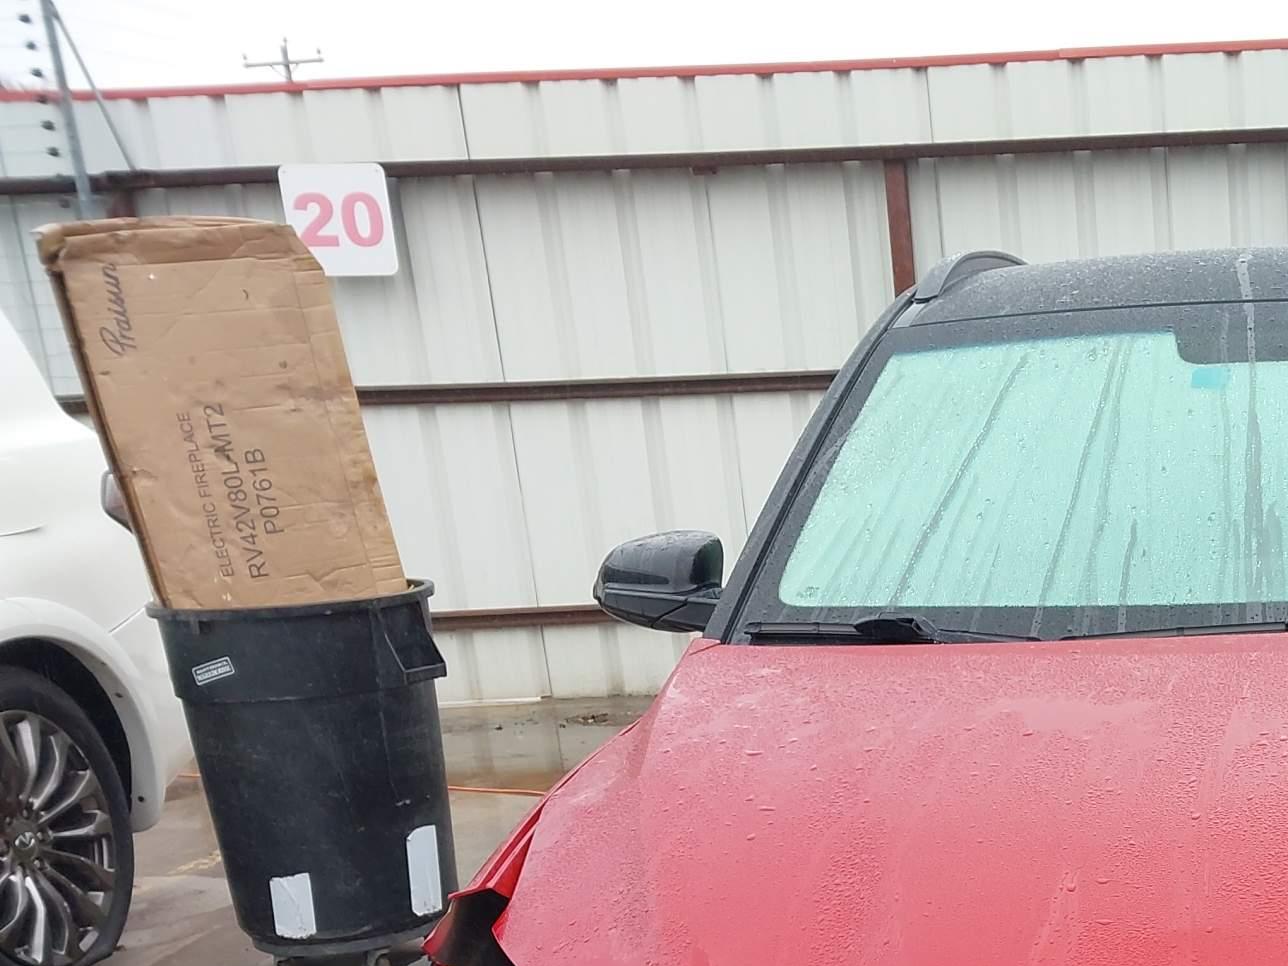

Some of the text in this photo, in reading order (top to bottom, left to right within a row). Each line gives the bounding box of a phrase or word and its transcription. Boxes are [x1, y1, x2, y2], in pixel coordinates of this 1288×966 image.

[293, 191, 384, 247] 20
[177, 412, 234, 578] ELECTRIC FIREPLACE
[244, 448, 285, 535] P0761B
